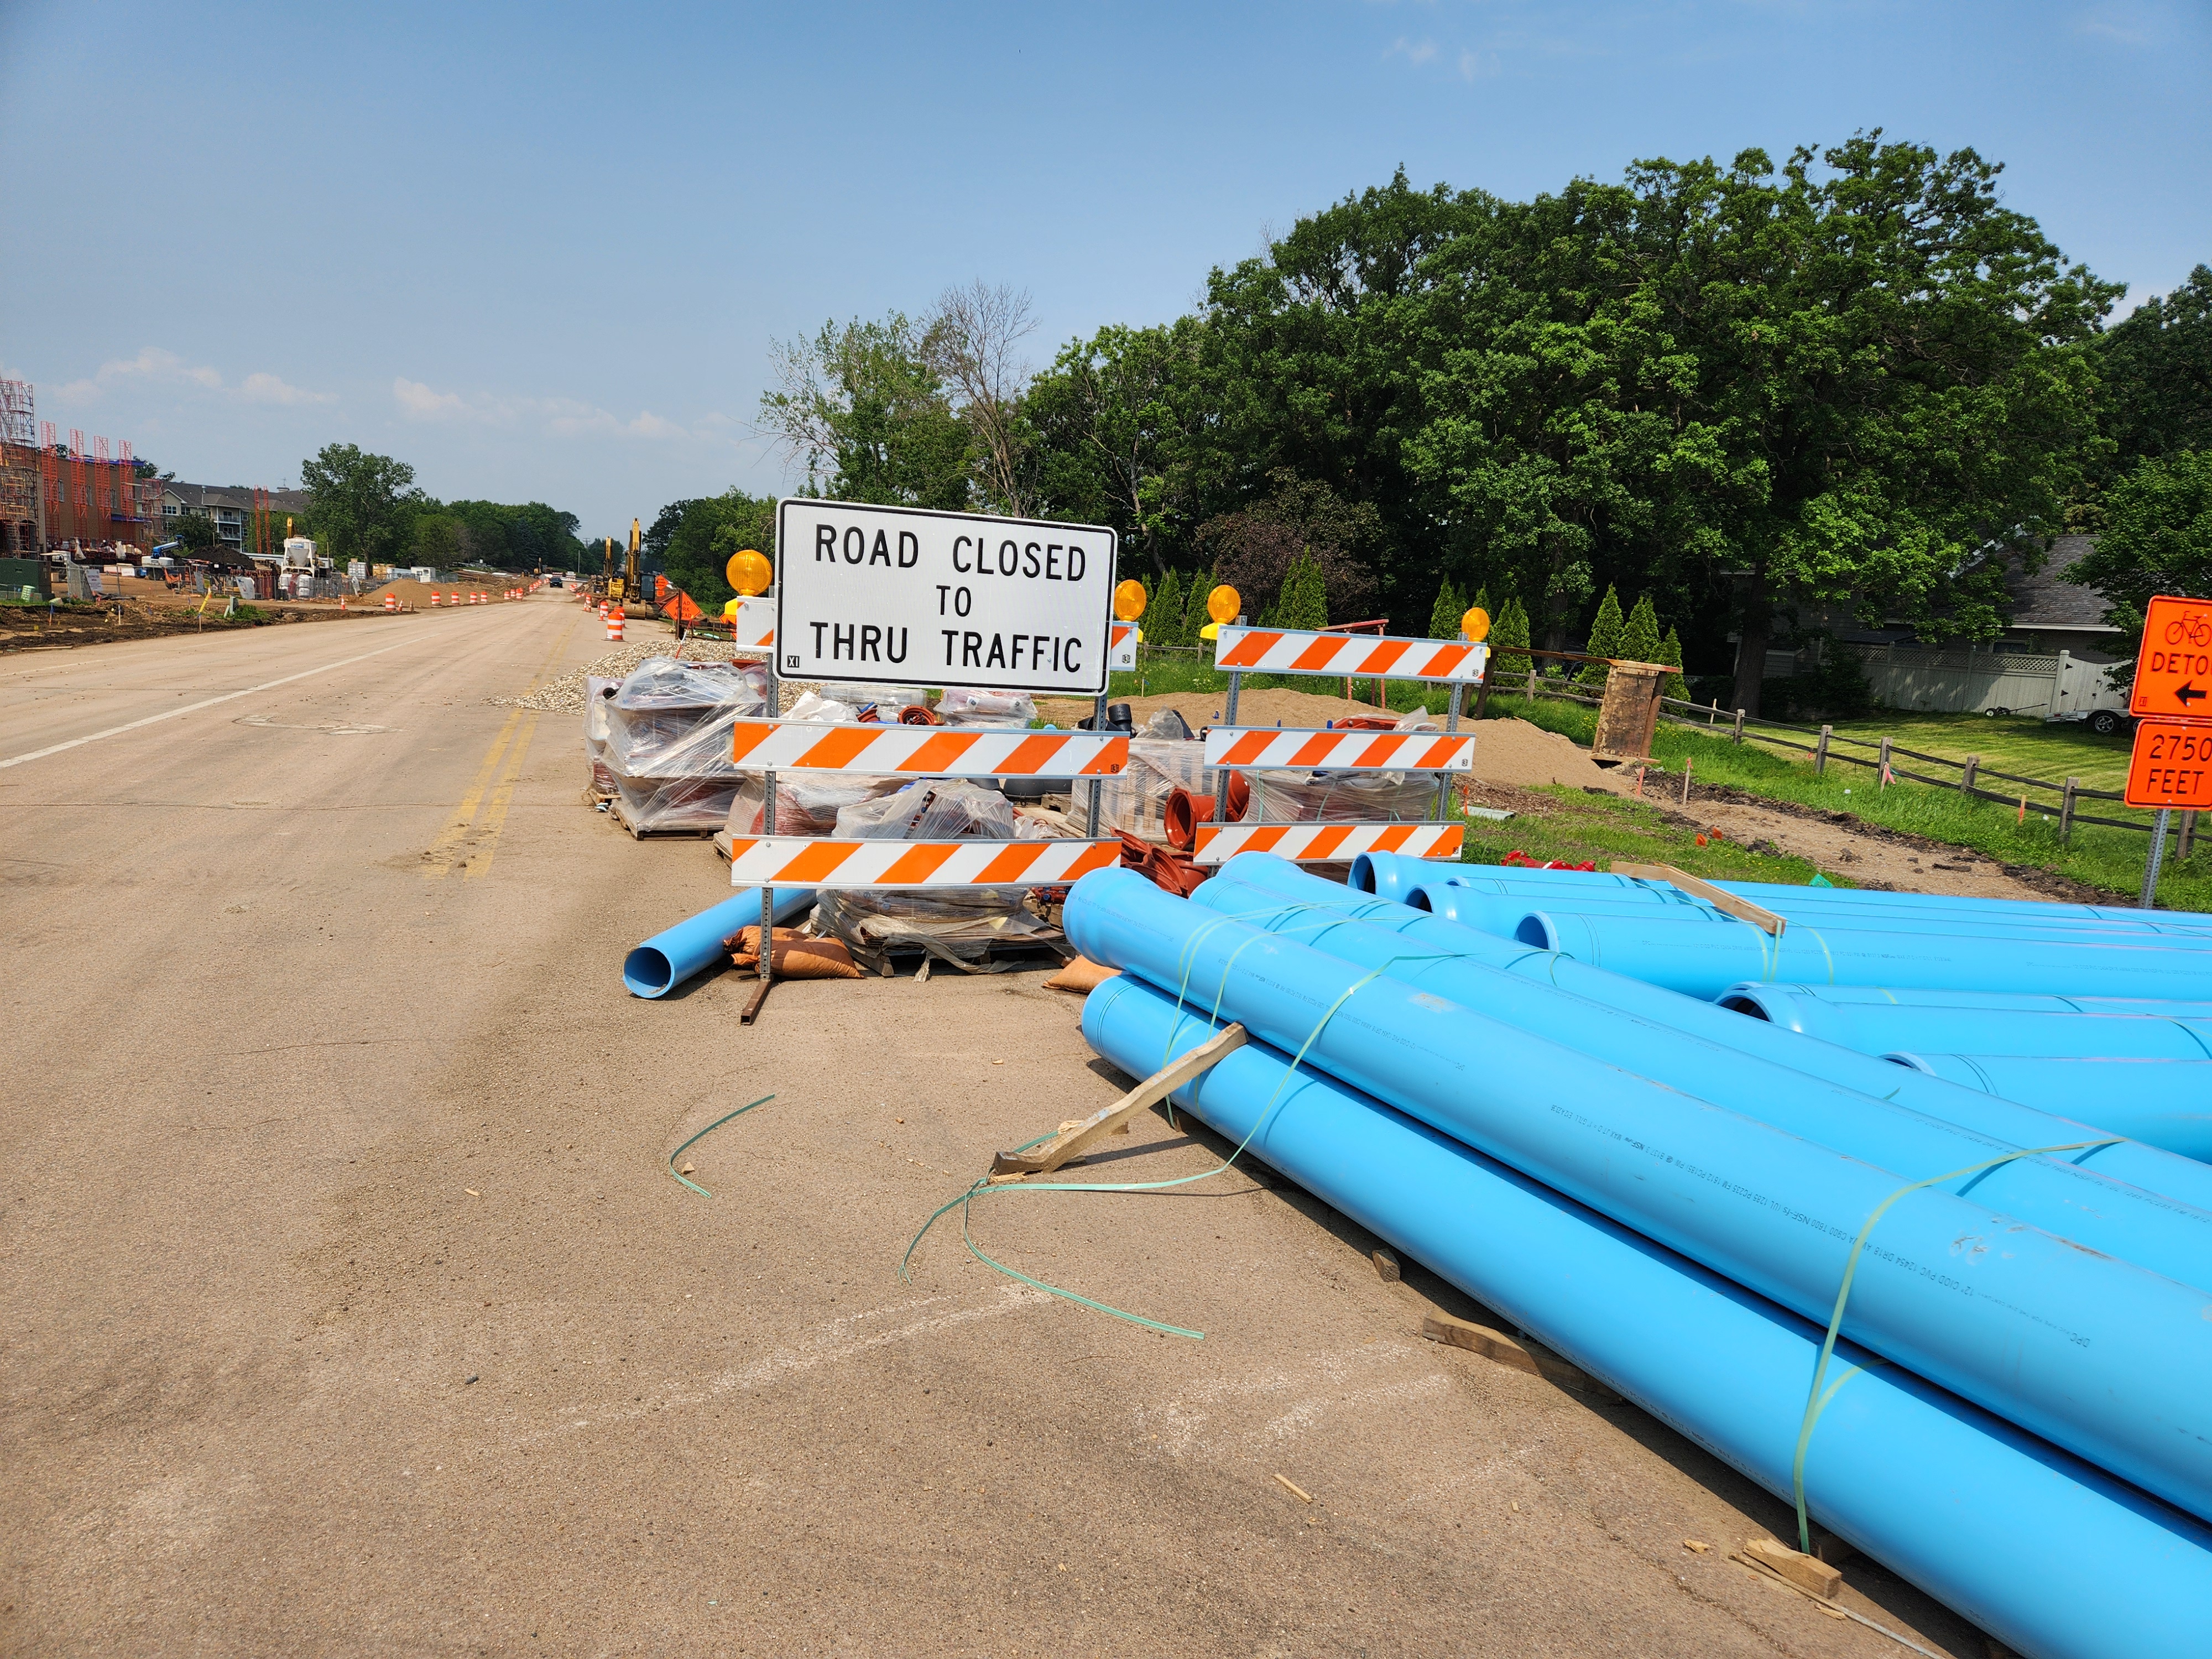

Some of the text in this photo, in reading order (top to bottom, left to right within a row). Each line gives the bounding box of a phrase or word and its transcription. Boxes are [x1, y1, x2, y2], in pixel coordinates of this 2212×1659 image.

[815, 524, 1086, 581] ROAD CLOSED
[936, 585, 972, 617] TO
[810, 622, 1082, 673] THRU TRAFFIC
[2150, 651, 2212, 676] DETO
[2150, 734, 2212, 762] 2750
[2147, 769, 2204, 794] FEET
[1706, 1172, 1721, 1185] 1612
[1721, 1180, 1732, 1190] FM
[1731, 1184, 1753, 1199] PC235
[1752, 1193, 1768, 1206] 1285
[1811, 1219, 1828, 1232] T600
[1828, 1227, 1847, 1240] C900
[1873, 1246, 1895, 1261] DR18
[1895, 1256, 1917, 1271] 12454
[1919, 1266, 1937, 1280] PVC
[1938, 1275, 1959, 1290] CIOD
[2069, 1332, 2090, 1348] DPC
